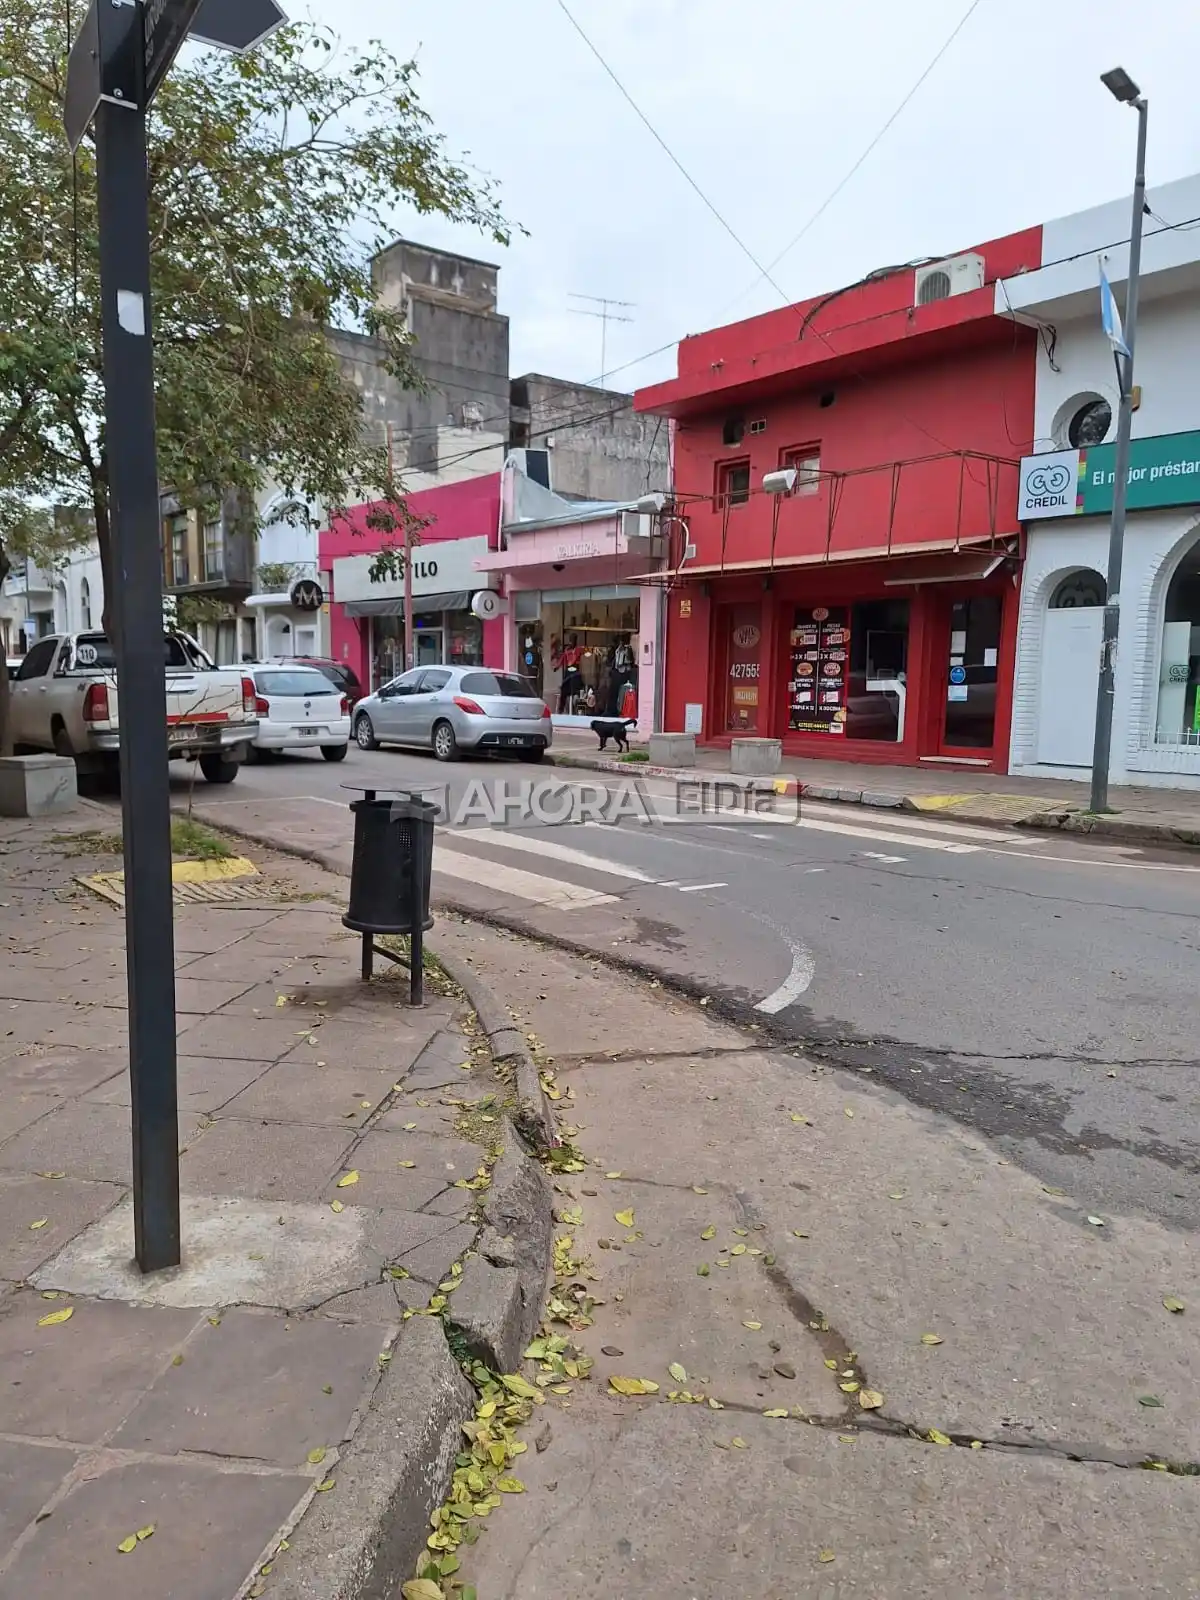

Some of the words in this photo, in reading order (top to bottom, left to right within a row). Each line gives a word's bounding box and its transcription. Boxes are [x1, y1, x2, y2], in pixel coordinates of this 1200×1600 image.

[1092, 470, 1105, 486] El
[1025, 495, 1069, 509] CREDIL
[389, 560, 438, 582] ESILO
[79, 648, 94, 660] 110
